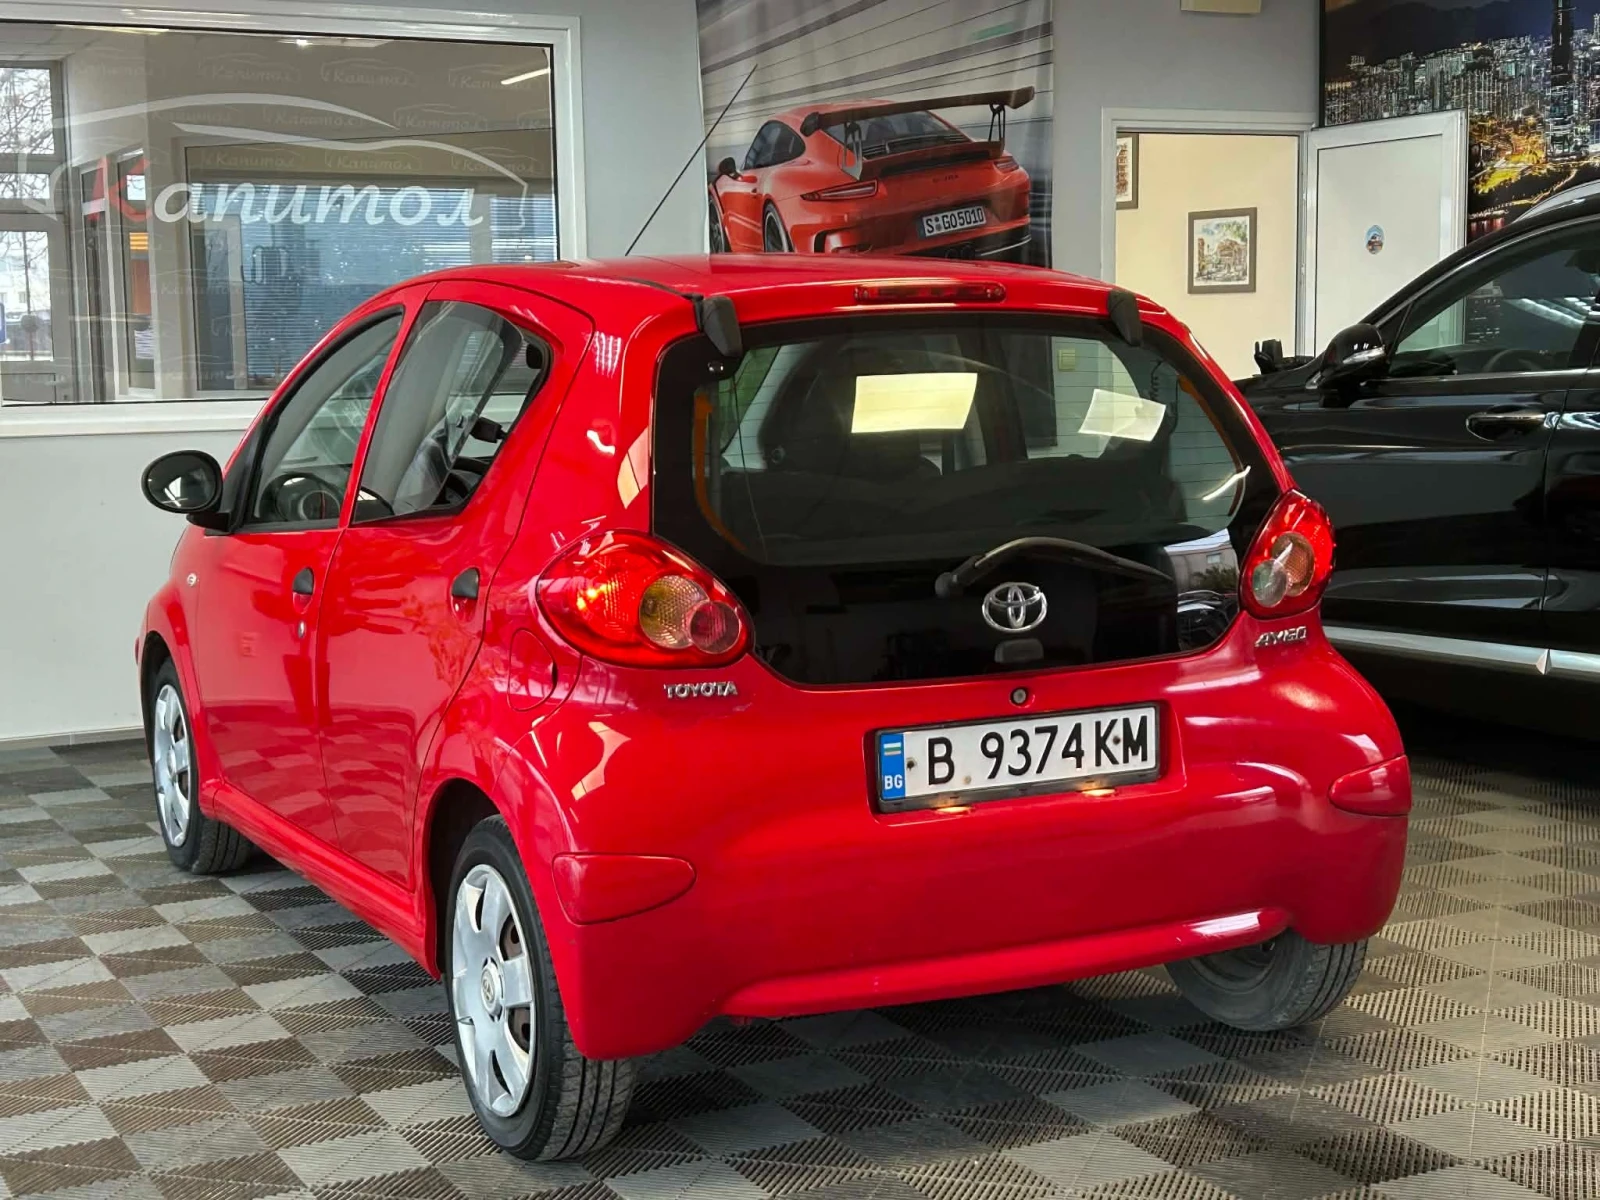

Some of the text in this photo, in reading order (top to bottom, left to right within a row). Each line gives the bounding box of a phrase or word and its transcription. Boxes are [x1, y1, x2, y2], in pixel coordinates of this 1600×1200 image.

[88, 157, 484, 226] Капитол
[663, 681, 738, 698] TOYOTA
[884, 774, 903, 790] BG
